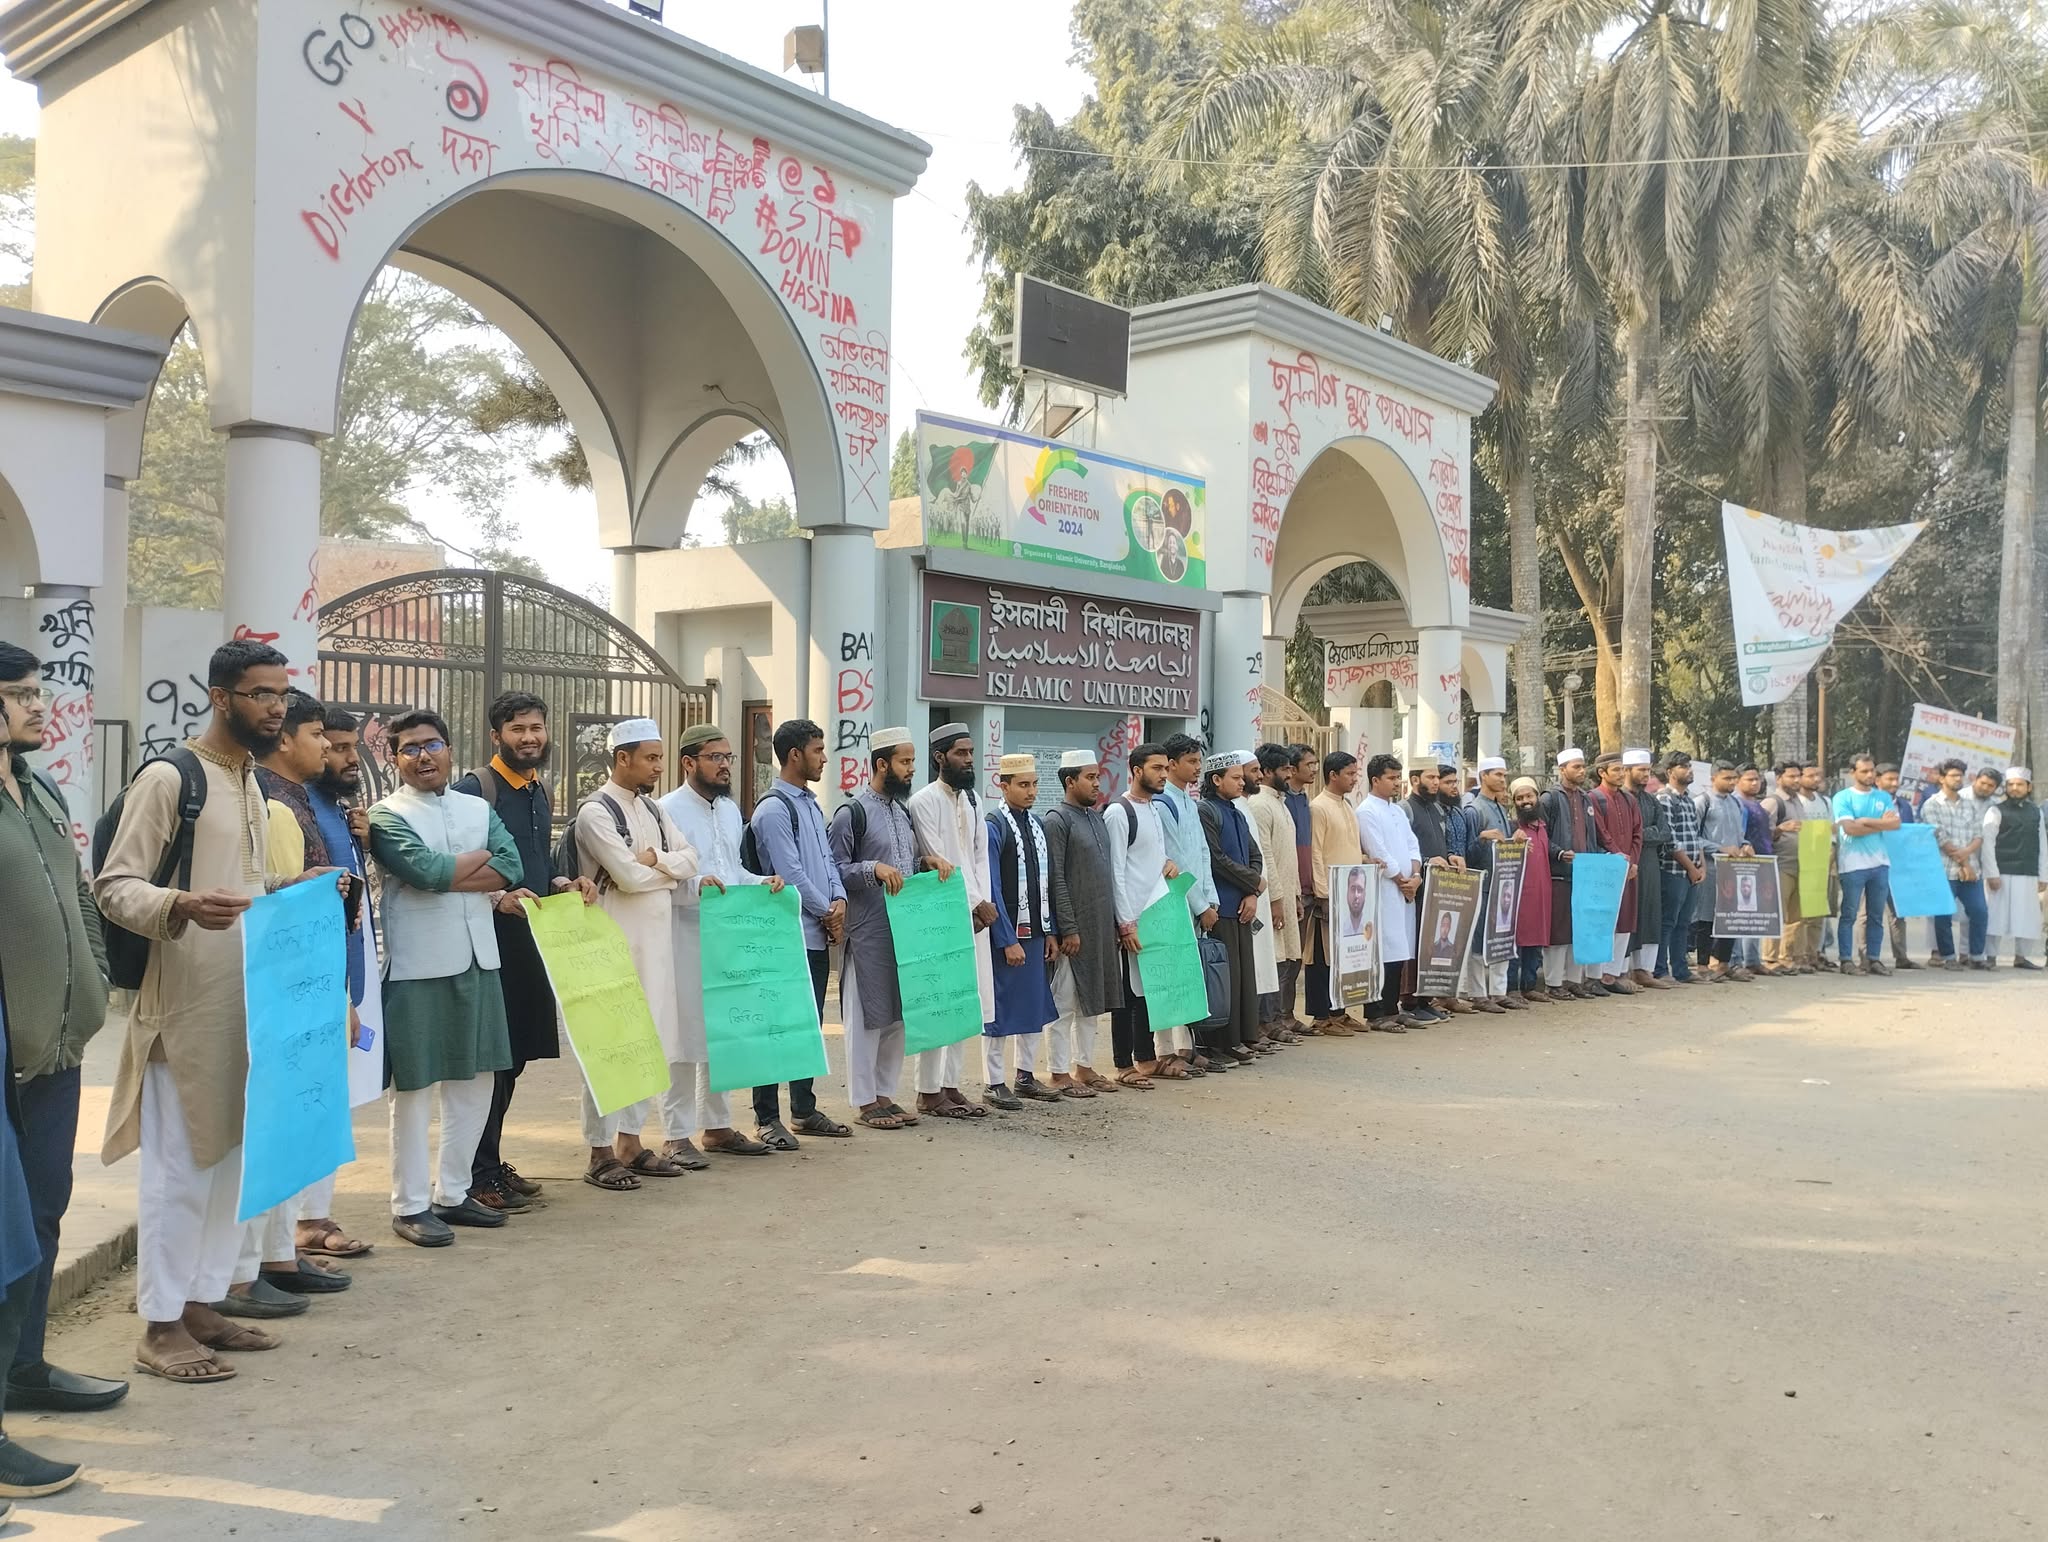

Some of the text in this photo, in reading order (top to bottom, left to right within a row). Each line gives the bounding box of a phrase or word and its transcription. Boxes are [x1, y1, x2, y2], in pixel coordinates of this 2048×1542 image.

[303, 12, 375, 86] GO
[509, 60, 607, 134] হাসিনা
[530, 111, 584, 165] খুনি
[760, 229, 830, 288] DOWN
[780, 269, 858, 326] HASINA
[825, 363, 886, 404] হাসিনার
[845, 431, 881, 474] চাই
[1038, 498, 1100, 522] ORIENTATION
[1058, 519, 1083, 537] 2024
[1056, 553, 1073, 563] Islamic
[1099, 560, 1127, 572] Bangladesh
[39, 600, 95, 648] খুনি
[988, 586, 1194, 651] ইসলামী বিশ্ববিদ্যালয়
[1104, 640, 1192, 683] الجامعة
[1368, 632, 1404, 659] নিপাত
[1404, 639, 1419, 655] যা
[41, 651, 95, 692] হাসি
[986, 671, 1193, 711] ISLAMIC UNIVERSITY
[1402, 673, 1419, 689] পা
[834, 719, 872, 751] BA
[839, 756, 871, 792] BA
[984, 719, 1002, 801] Politics
